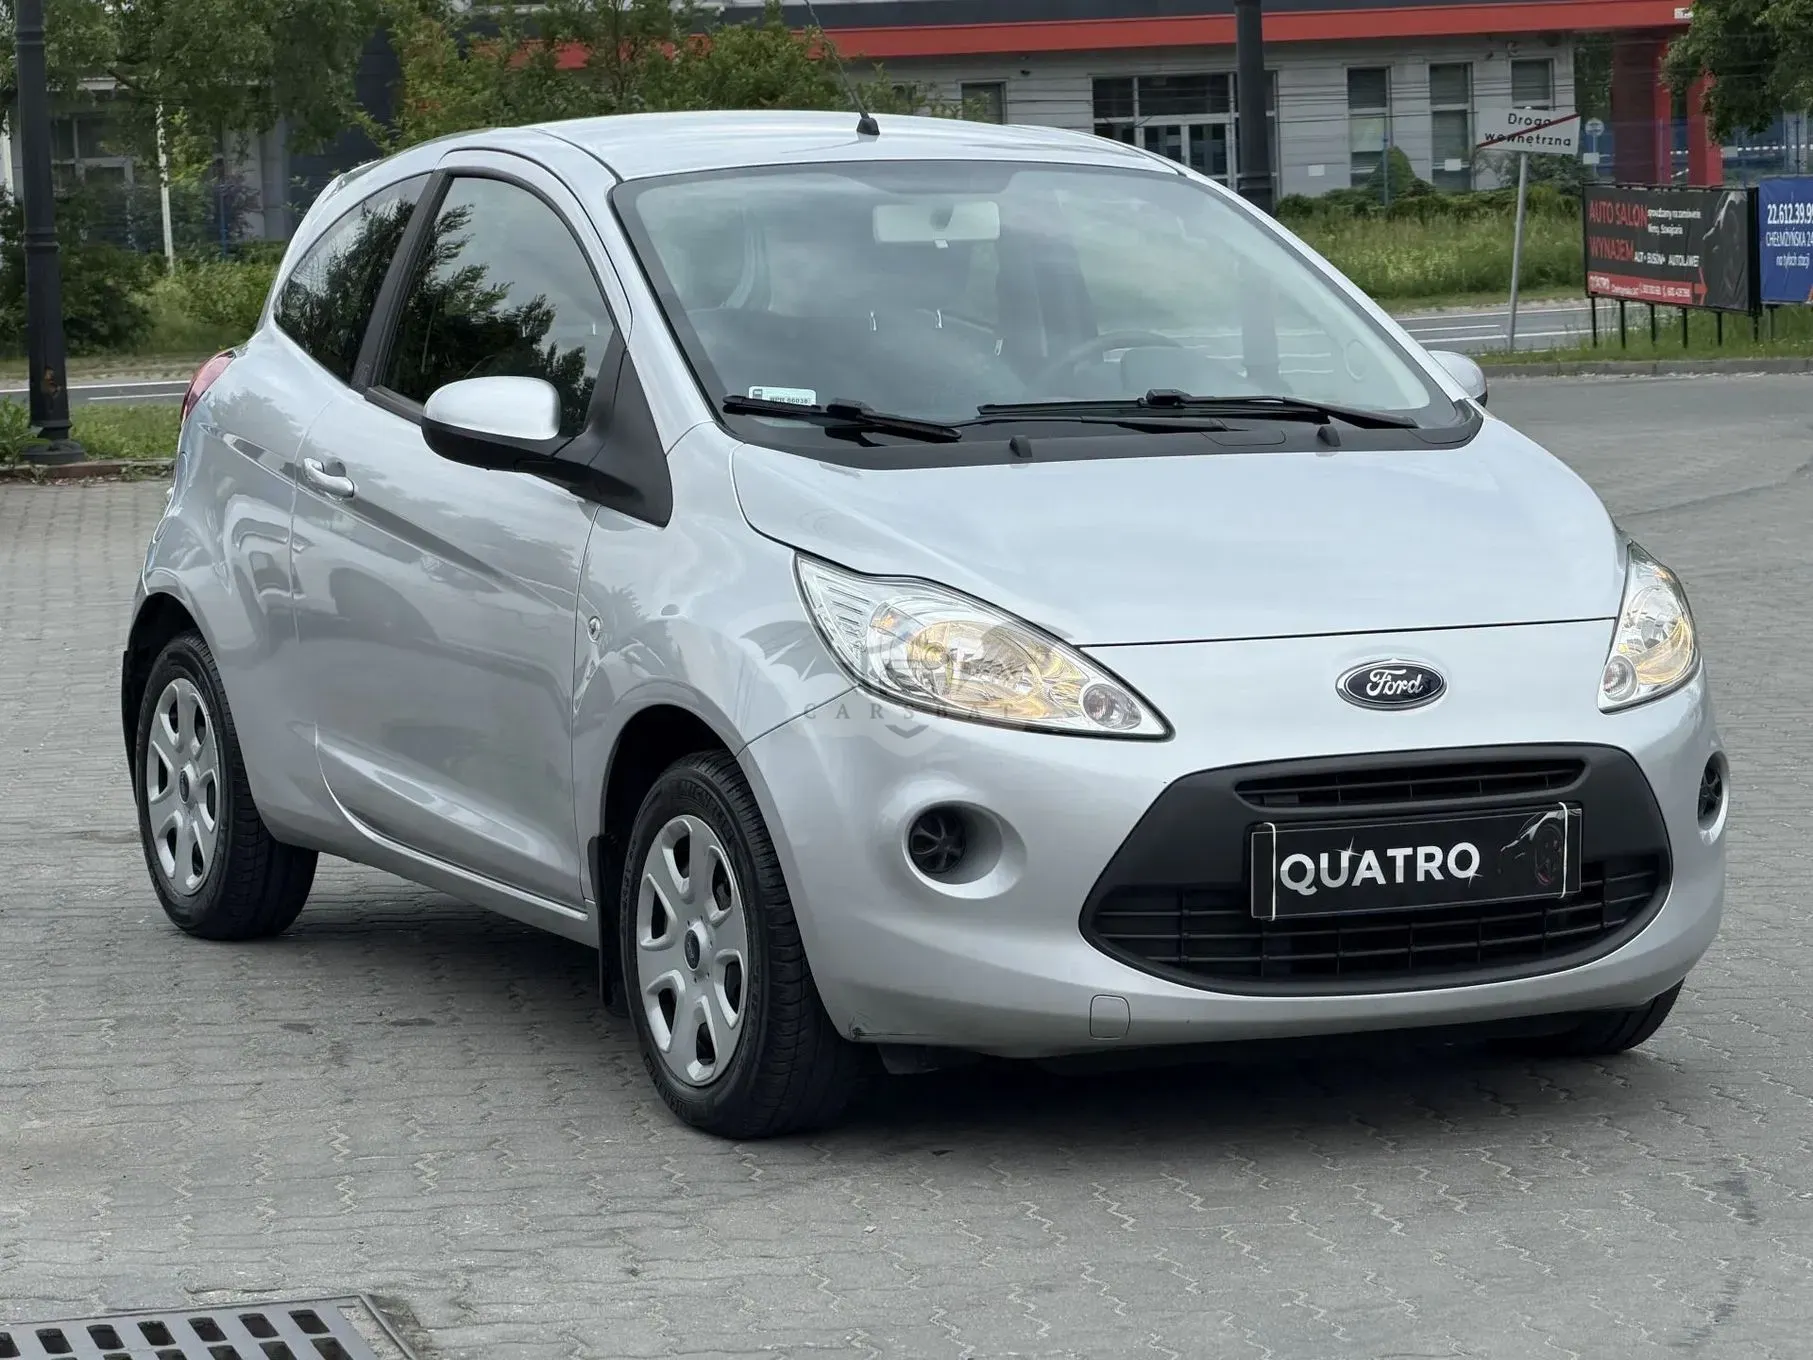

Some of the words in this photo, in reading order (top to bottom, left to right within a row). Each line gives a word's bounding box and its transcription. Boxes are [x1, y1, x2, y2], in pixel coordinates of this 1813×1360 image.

[1507, 113, 1552, 128] Droga
[1484, 132, 1572, 147] wewnętrzna
[1589, 200, 1614, 224] AUTO
[1616, 202, 1648, 228] SALON
[1767, 202, 1813, 225] 22.612.39.9
[1589, 236, 1634, 263] WYNAJEM
[1365, 668, 1423, 697] Ford
[1279, 842, 1481, 897] QUATRO
